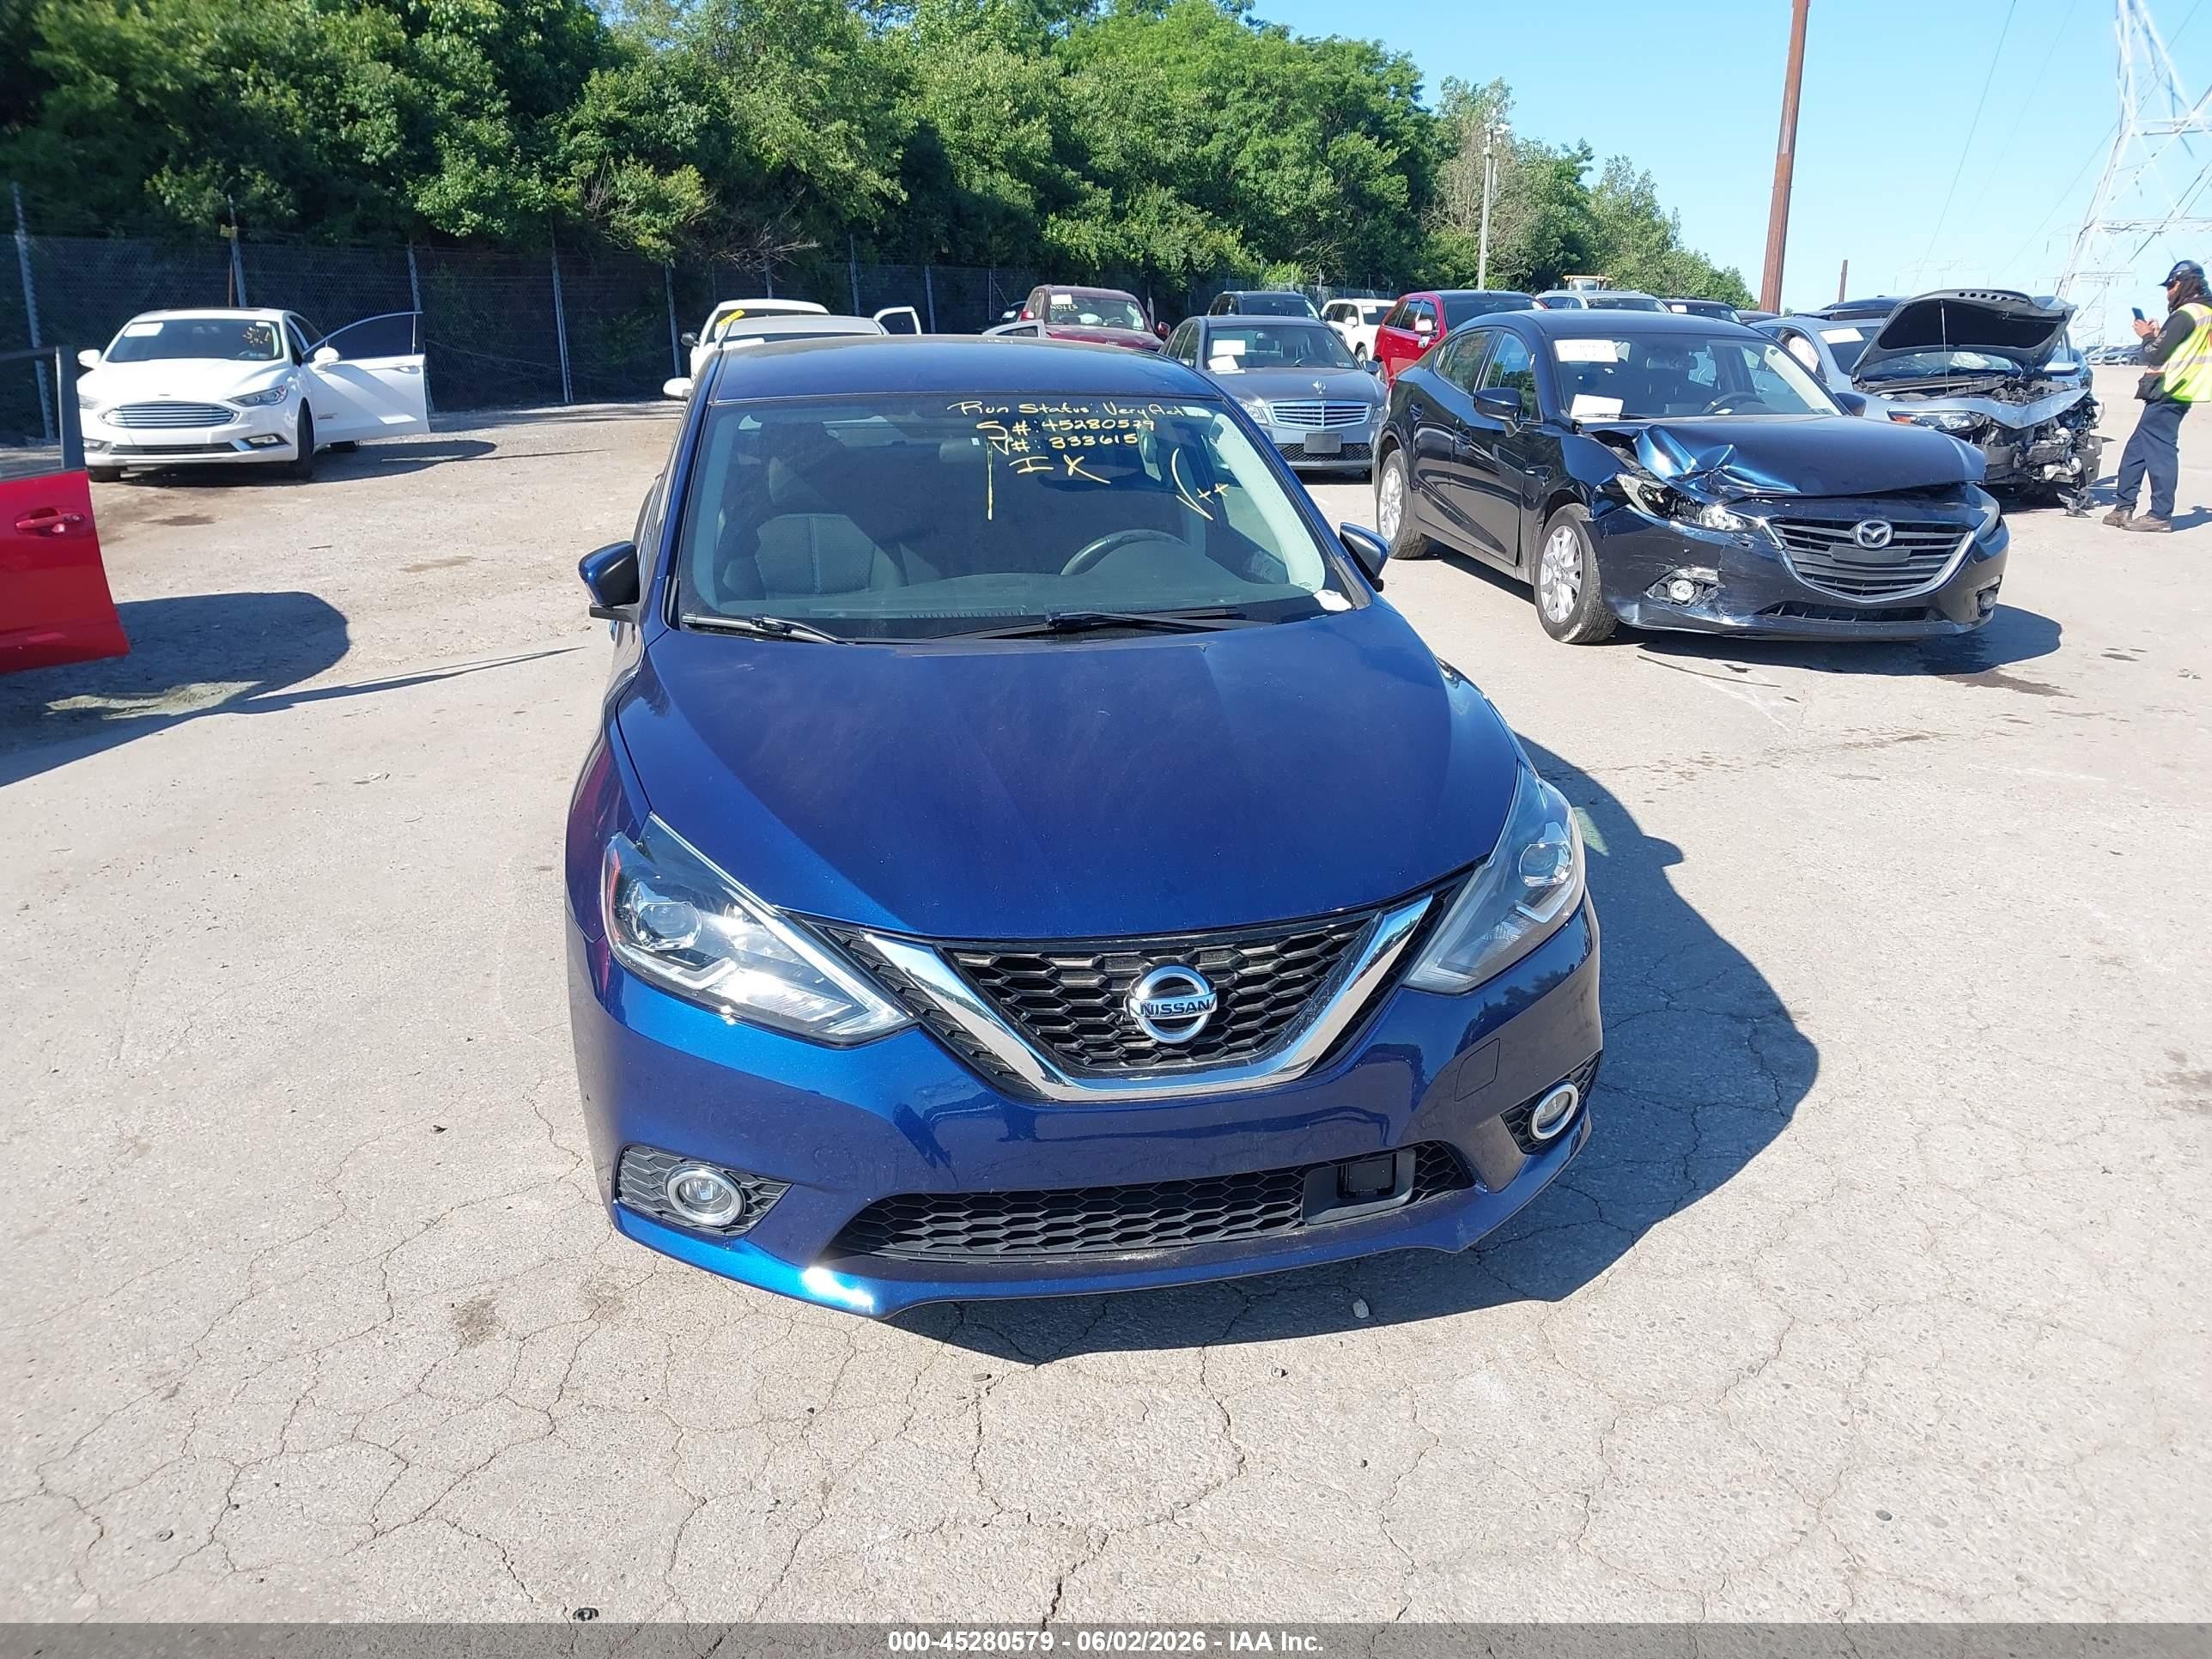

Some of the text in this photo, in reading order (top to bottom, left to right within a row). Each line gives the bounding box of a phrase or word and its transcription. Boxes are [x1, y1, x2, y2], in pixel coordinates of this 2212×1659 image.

[946, 400, 1009, 416] Run
[1048, 433, 1139, 449] 333615
[1139, 999, 1211, 1017] NISSAN
